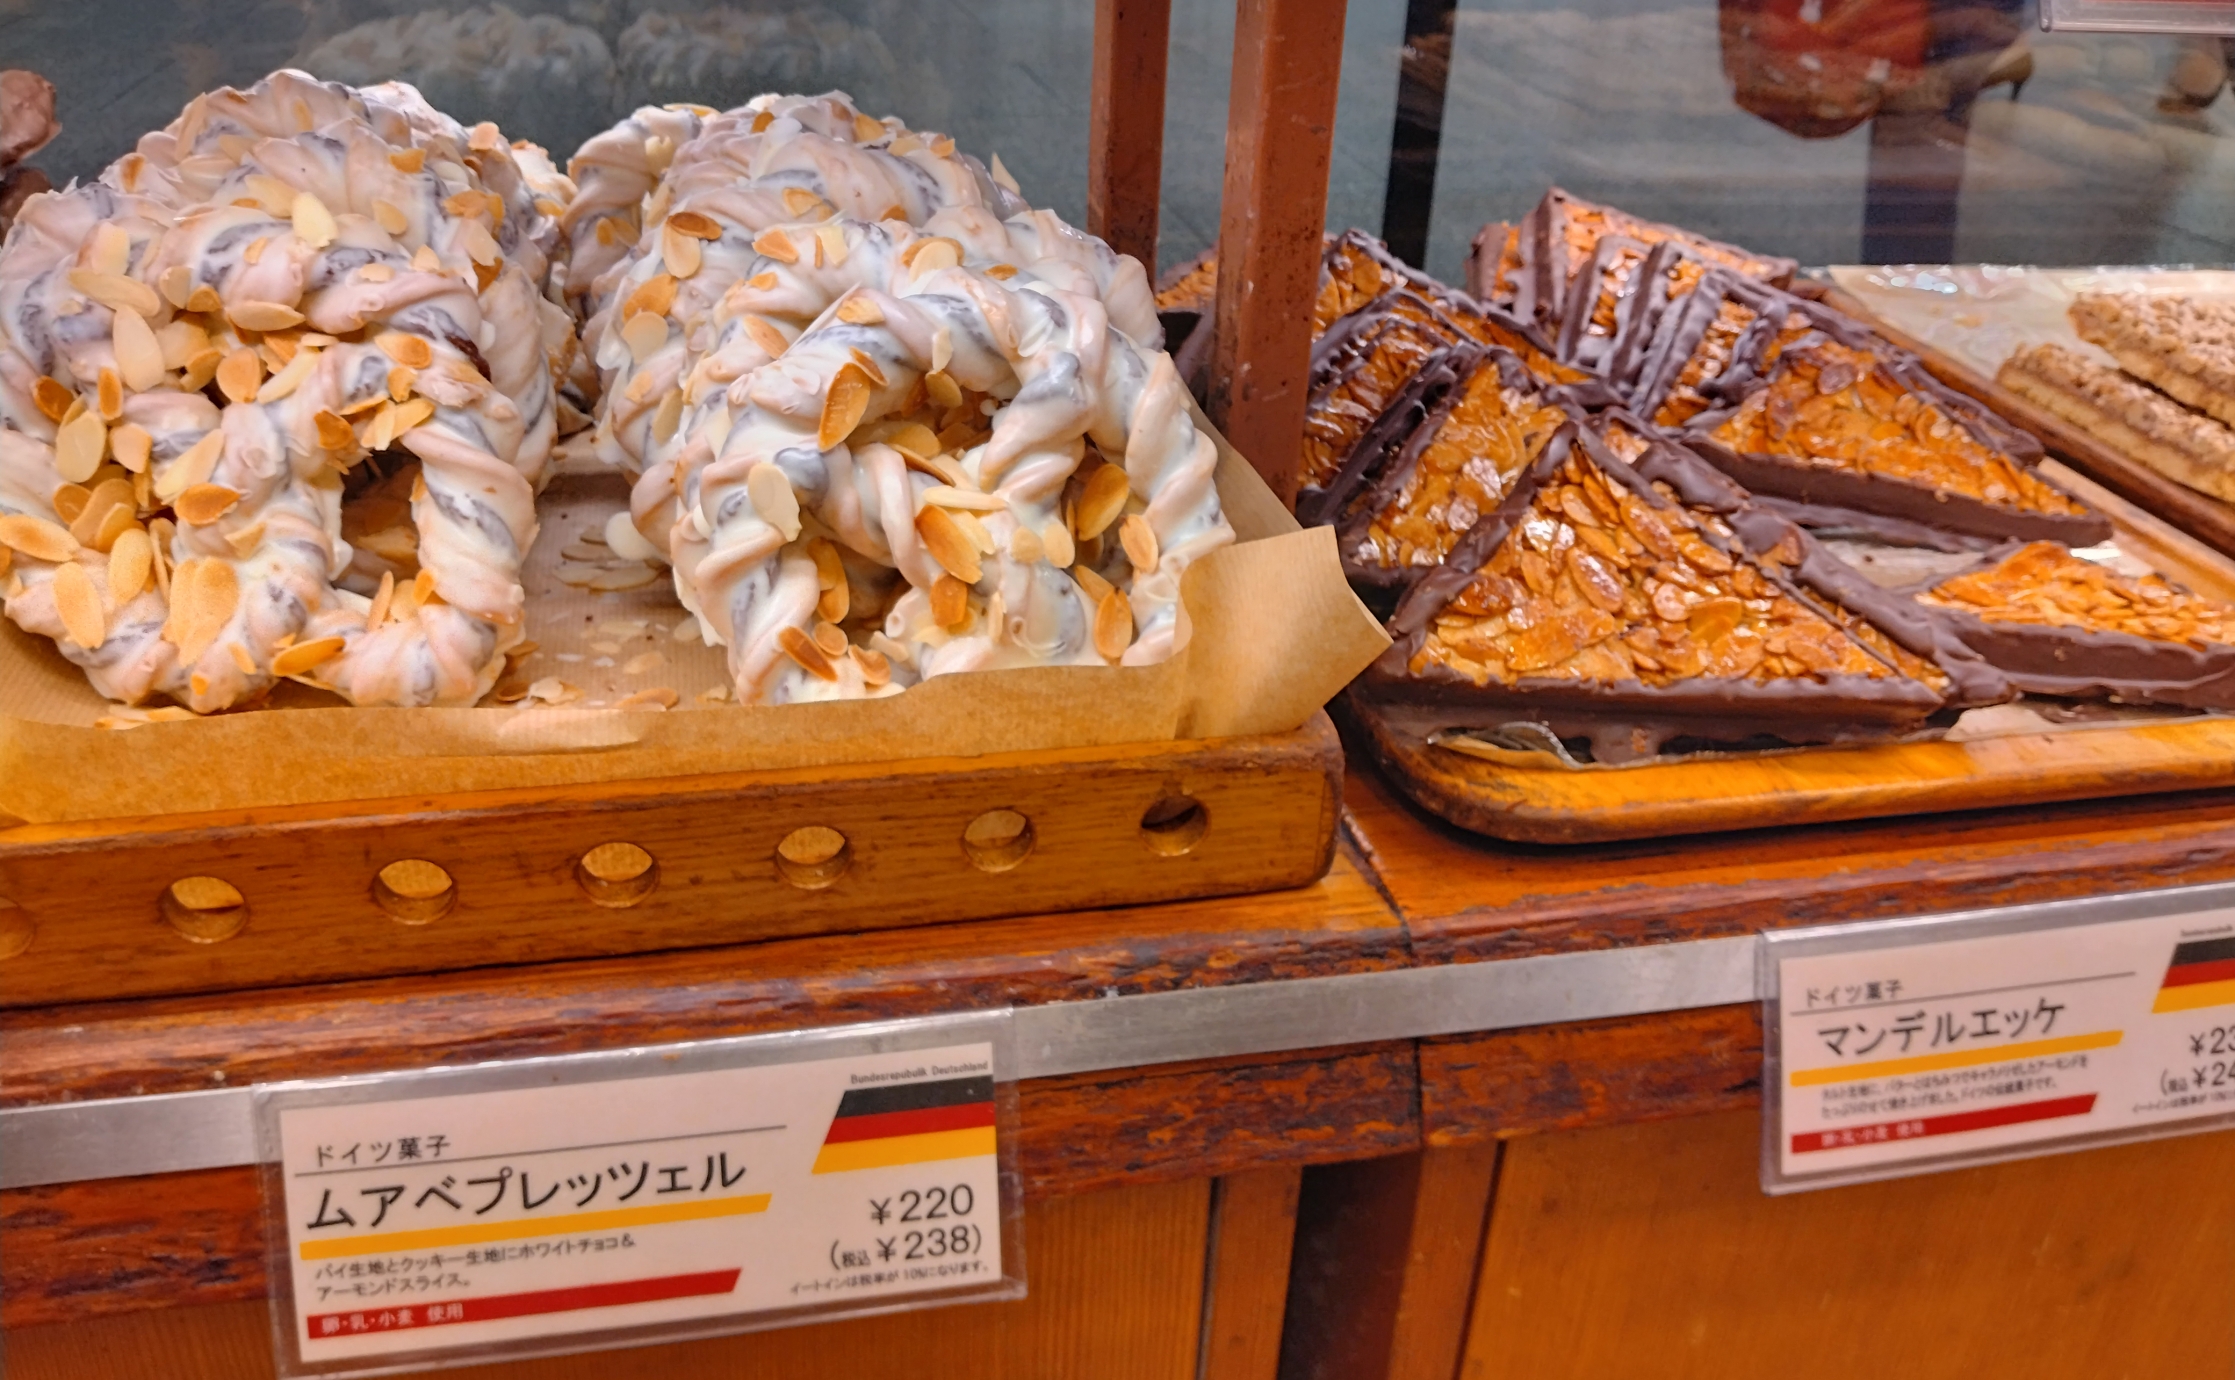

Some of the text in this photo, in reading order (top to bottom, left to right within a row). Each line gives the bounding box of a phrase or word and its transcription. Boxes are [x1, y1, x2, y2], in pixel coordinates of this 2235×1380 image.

[1806, 979, 1903, 1008] ドイツ菓子
[1817, 997, 2066, 1057] マンデルエッケ
[931, 1060, 989, 1077] Deutschland
[316, 1134, 450, 1168] ドイツ菓子
[306, 1151, 747, 1230] ムアベプレッツェル
[869, 1183, 975, 1226] ¥220
[316, 1272, 471, 1302] アーモンドスライス。
